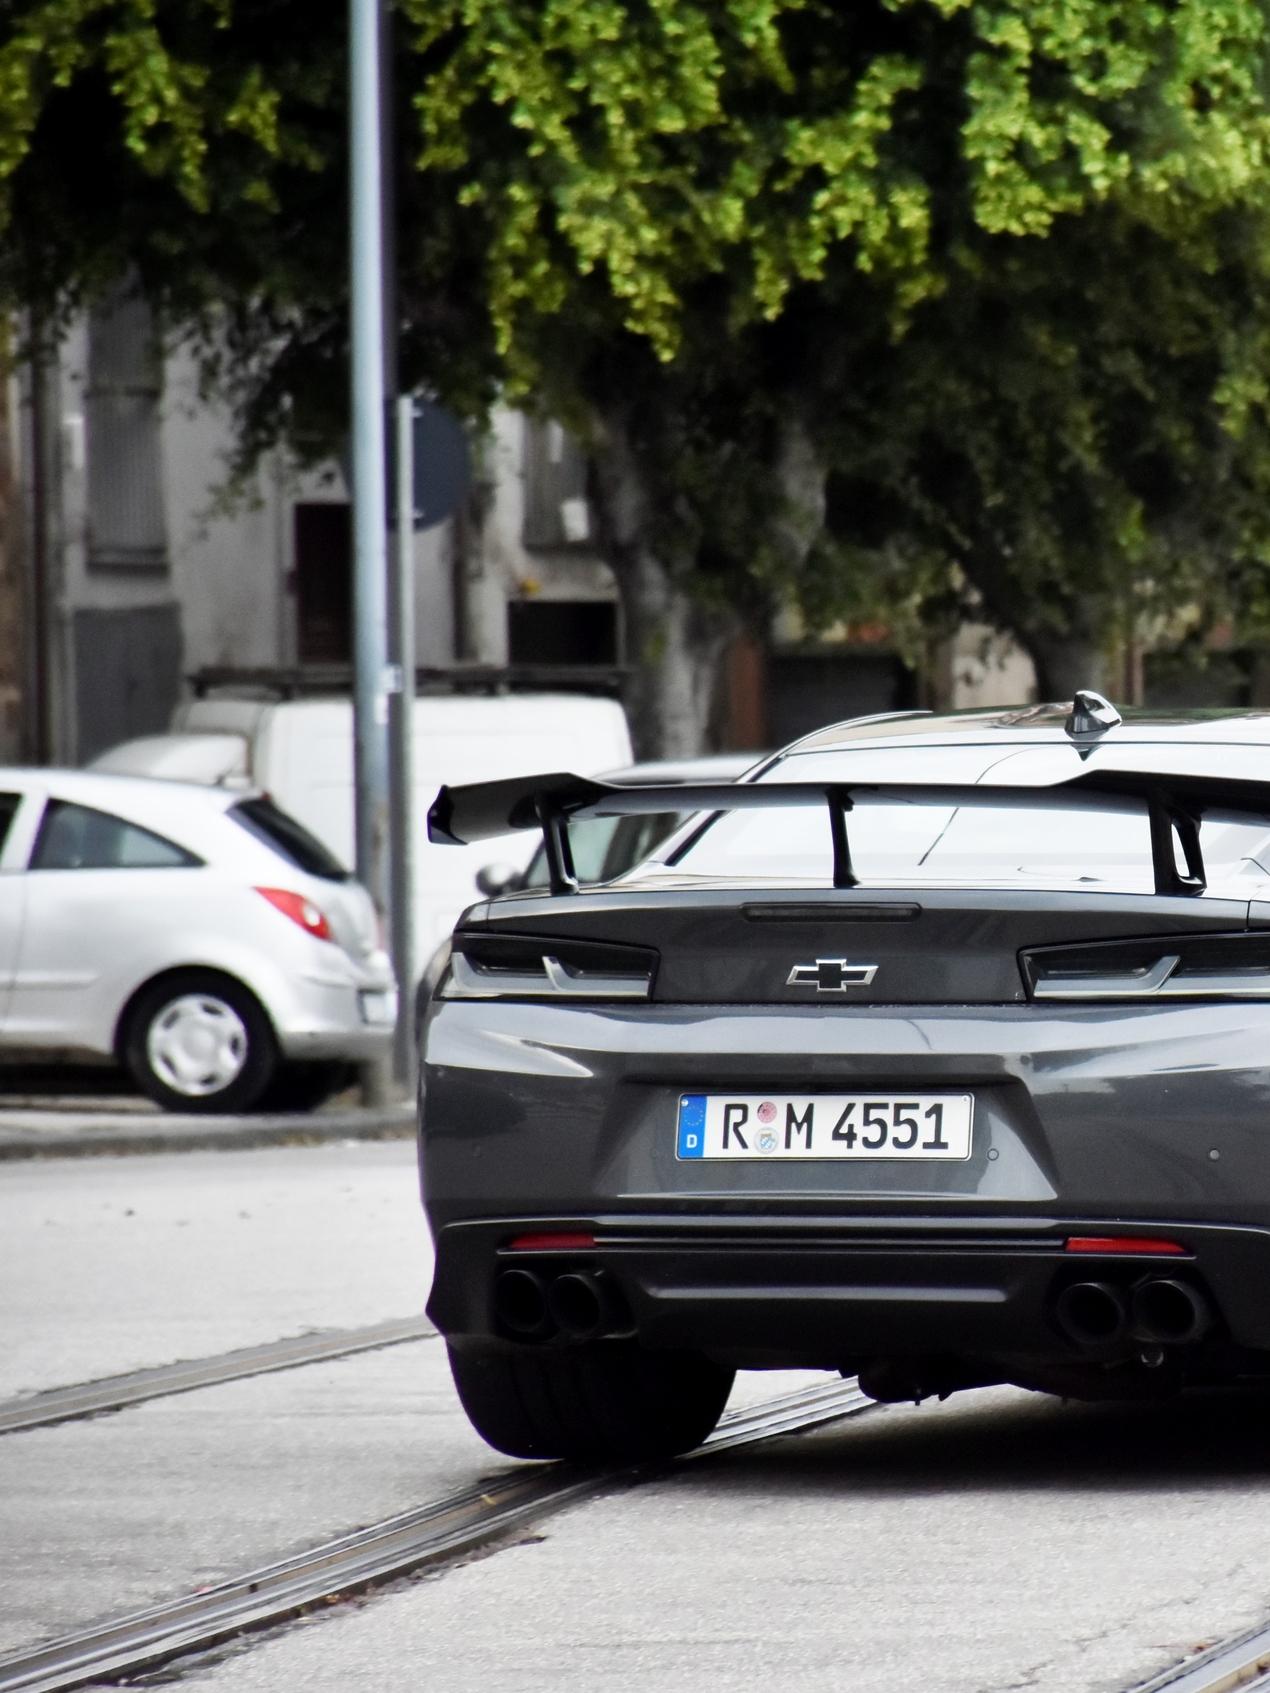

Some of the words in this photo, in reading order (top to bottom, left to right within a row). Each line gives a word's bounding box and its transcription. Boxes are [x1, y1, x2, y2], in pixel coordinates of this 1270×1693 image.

[686, 1134, 698, 1149] D
[722, 1103, 749, 1150] R
[784, 1103, 815, 1150] M
[831, 1103, 949, 1150] 4551
